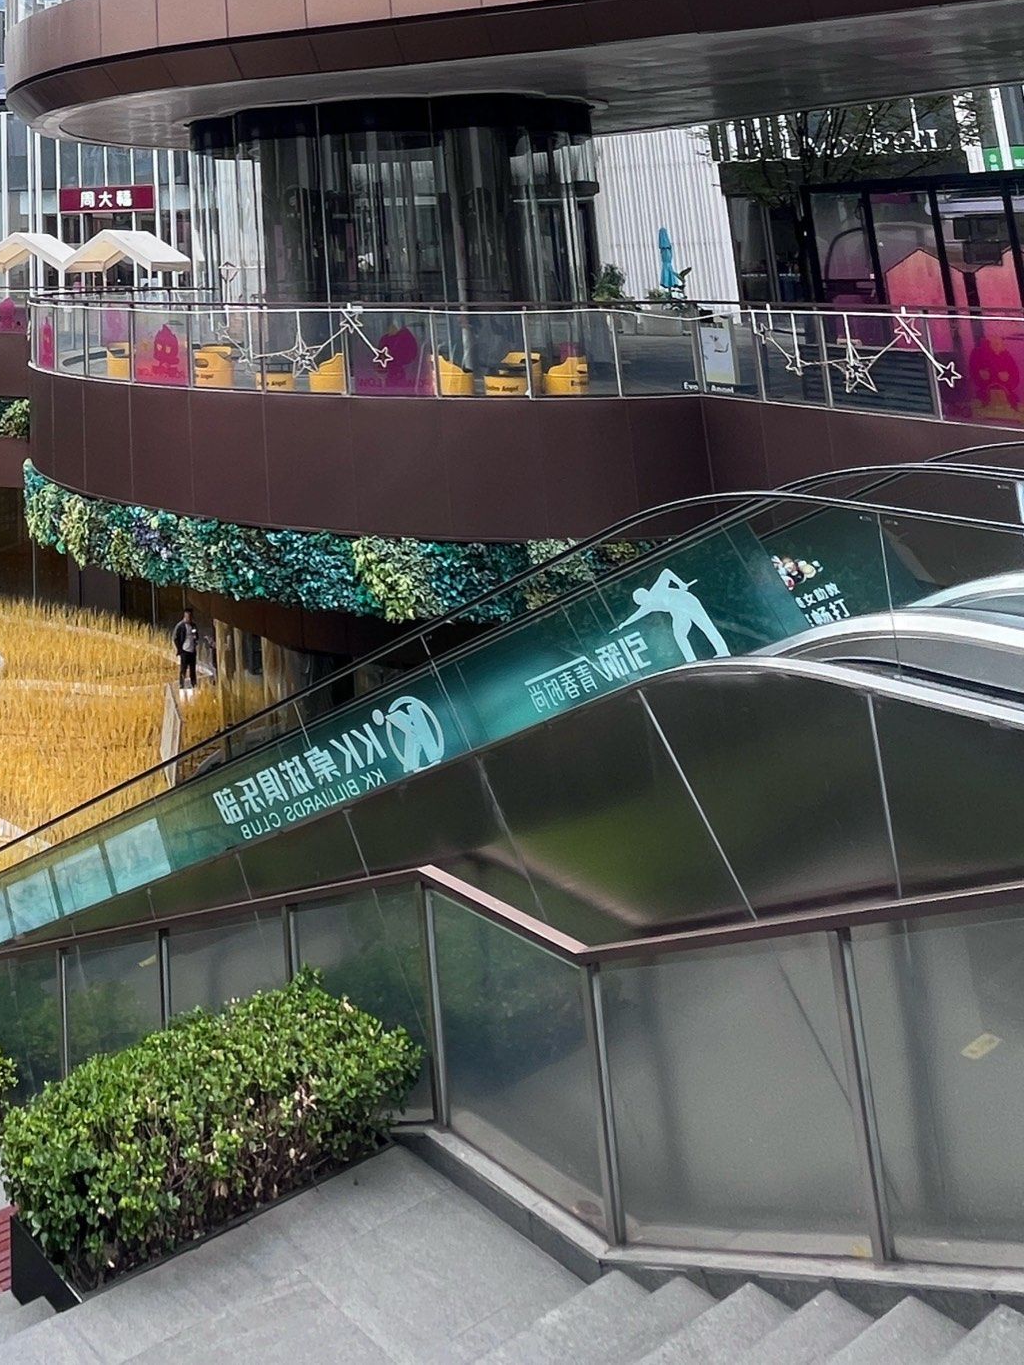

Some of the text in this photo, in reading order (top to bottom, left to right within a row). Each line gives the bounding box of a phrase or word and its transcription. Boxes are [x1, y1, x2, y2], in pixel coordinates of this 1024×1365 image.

[79, 189, 133, 208] 周大福
[805, 598, 851, 628] 畅打
